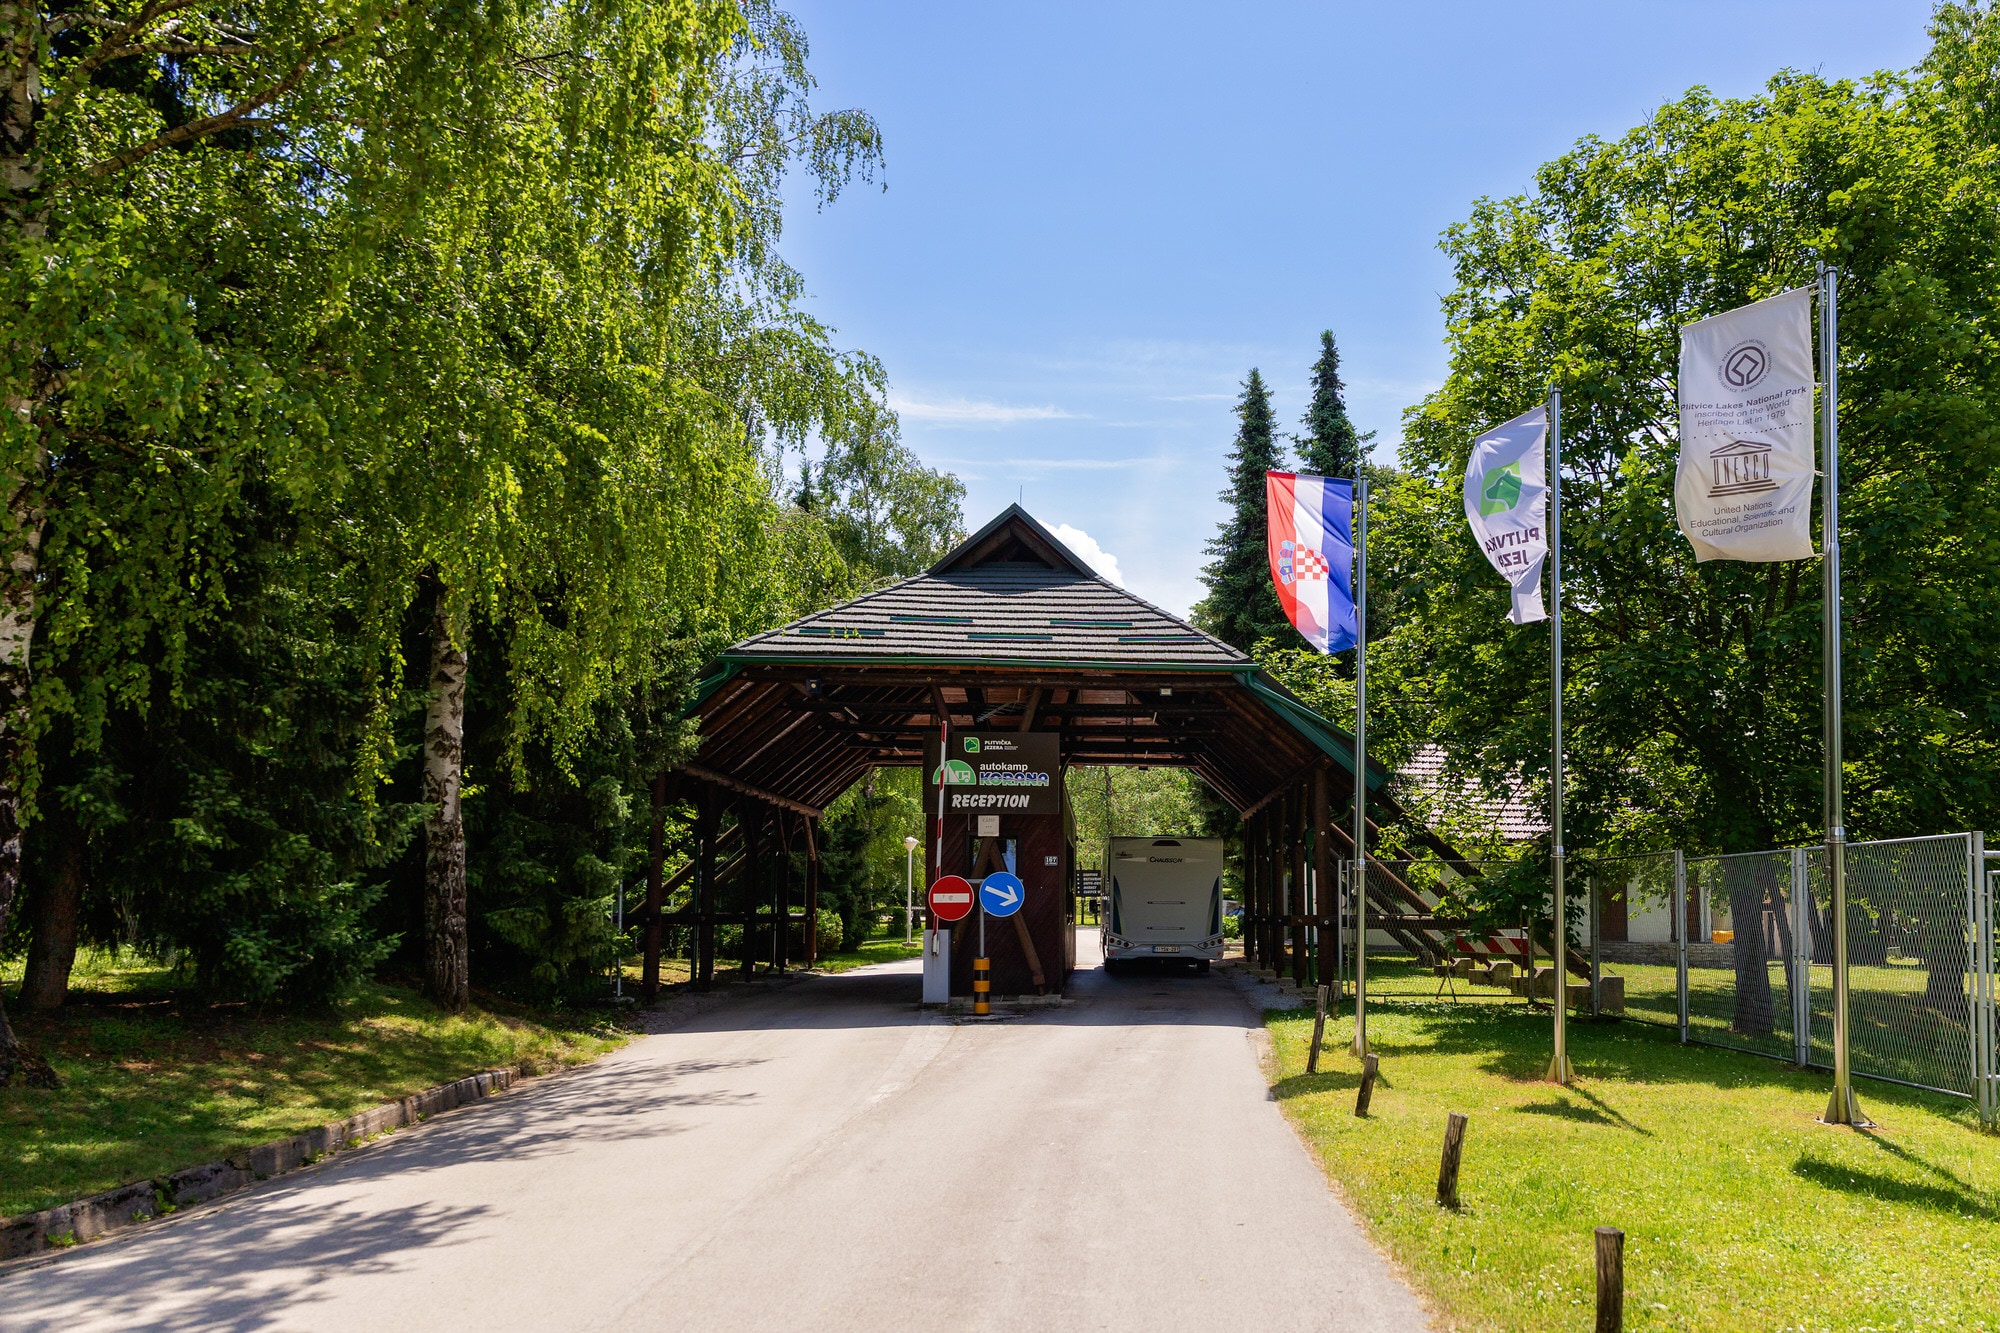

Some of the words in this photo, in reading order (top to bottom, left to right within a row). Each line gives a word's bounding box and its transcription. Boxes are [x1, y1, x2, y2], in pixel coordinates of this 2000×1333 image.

[1680, 402, 1713, 411] Plitvice
[1746, 391, 1783, 406] National
[1785, 386, 1807, 396] Park
[1694, 410, 1734, 418] inscribed
[1750, 407, 1764, 415] the
[1766, 399, 1790, 411] World
[1697, 419, 1735, 427] Heritage
[1737, 417, 1753, 426] List
[1767, 409, 1786, 420] 1979
[1713, 453, 1769, 485] UNESCO
[1690, 515, 1741, 528] Educational,
[1743, 509, 1777, 522] Scientific
[1777, 506, 1795, 515] and
[1713, 505, 1741, 515] United
[1743, 501, 1773, 511] Nations
[1701, 525, 1733, 537] Cultural
[1734, 518, 1783, 533] Organization
[979, 762, 1029, 772] autokamp
[979, 772, 1050, 787] KORANA
[952, 794, 1030, 808] RECEPTION
